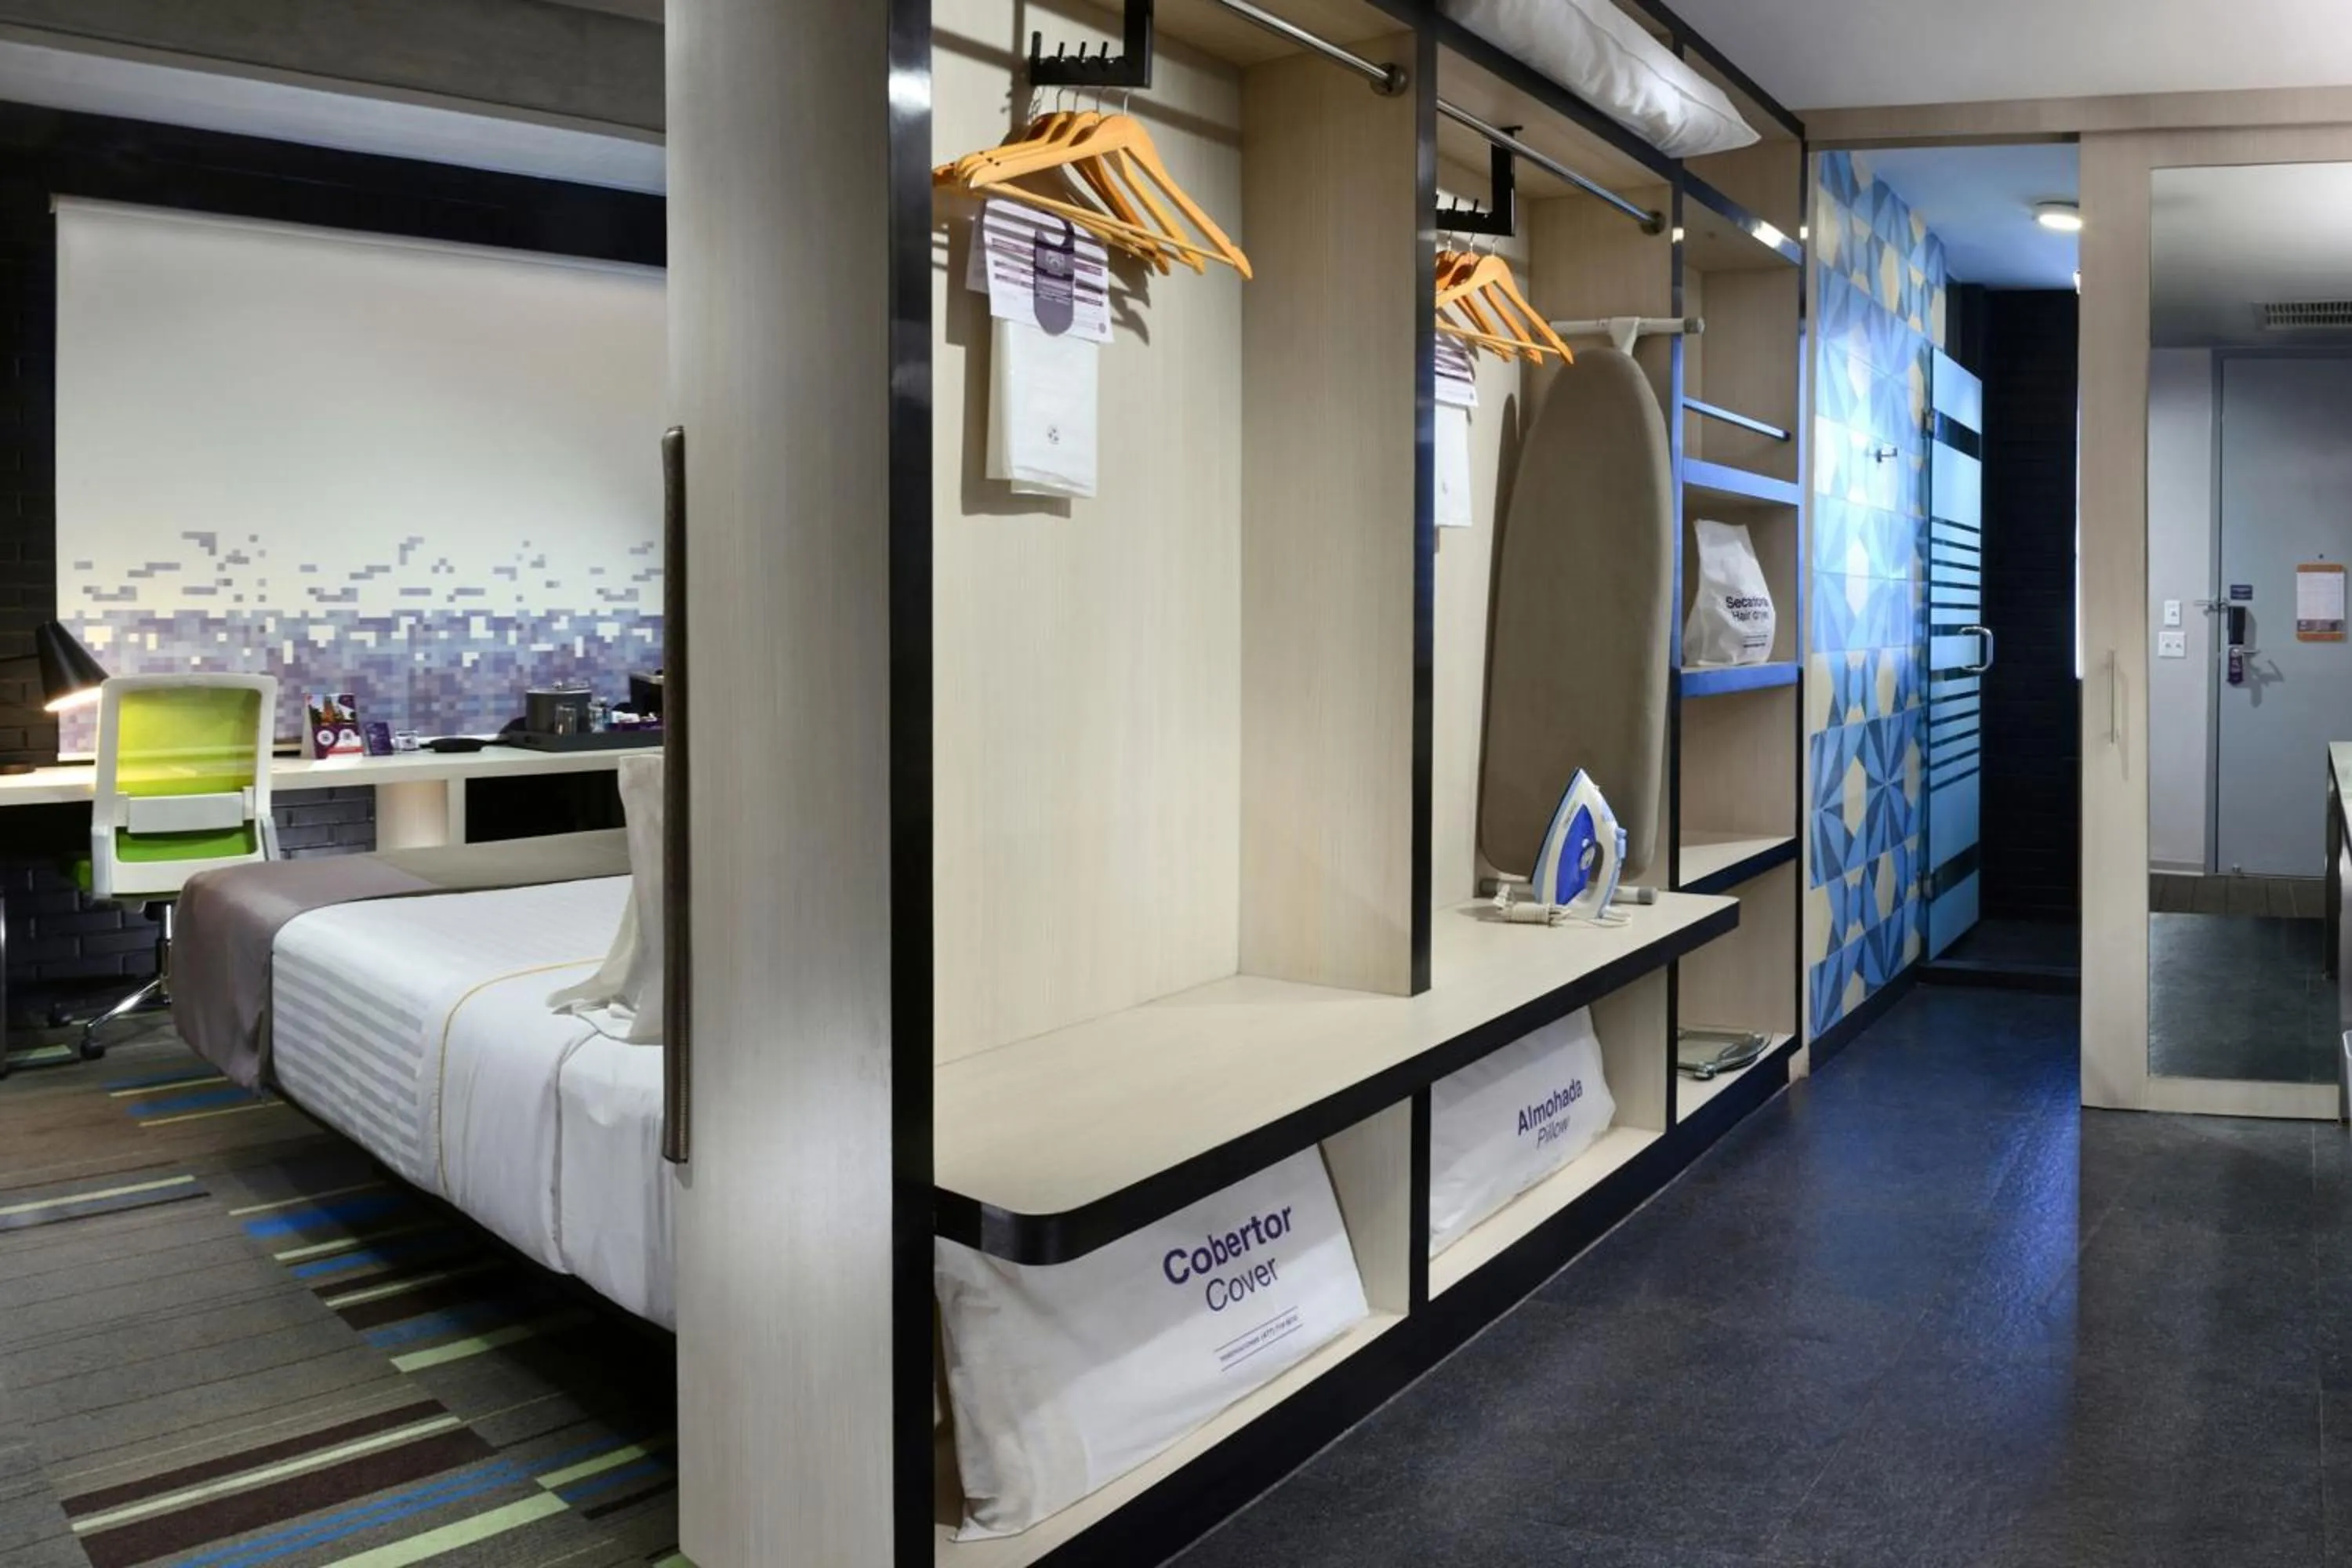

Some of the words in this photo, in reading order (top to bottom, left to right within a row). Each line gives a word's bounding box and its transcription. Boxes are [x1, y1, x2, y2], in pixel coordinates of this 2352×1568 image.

[1518, 1078, 1583, 1136] Almohada
[1537, 1115, 1570, 1149] Pillow
[1163, 1206, 1292, 1285] Cobertor
[1206, 1258, 1278, 1311] Cover
